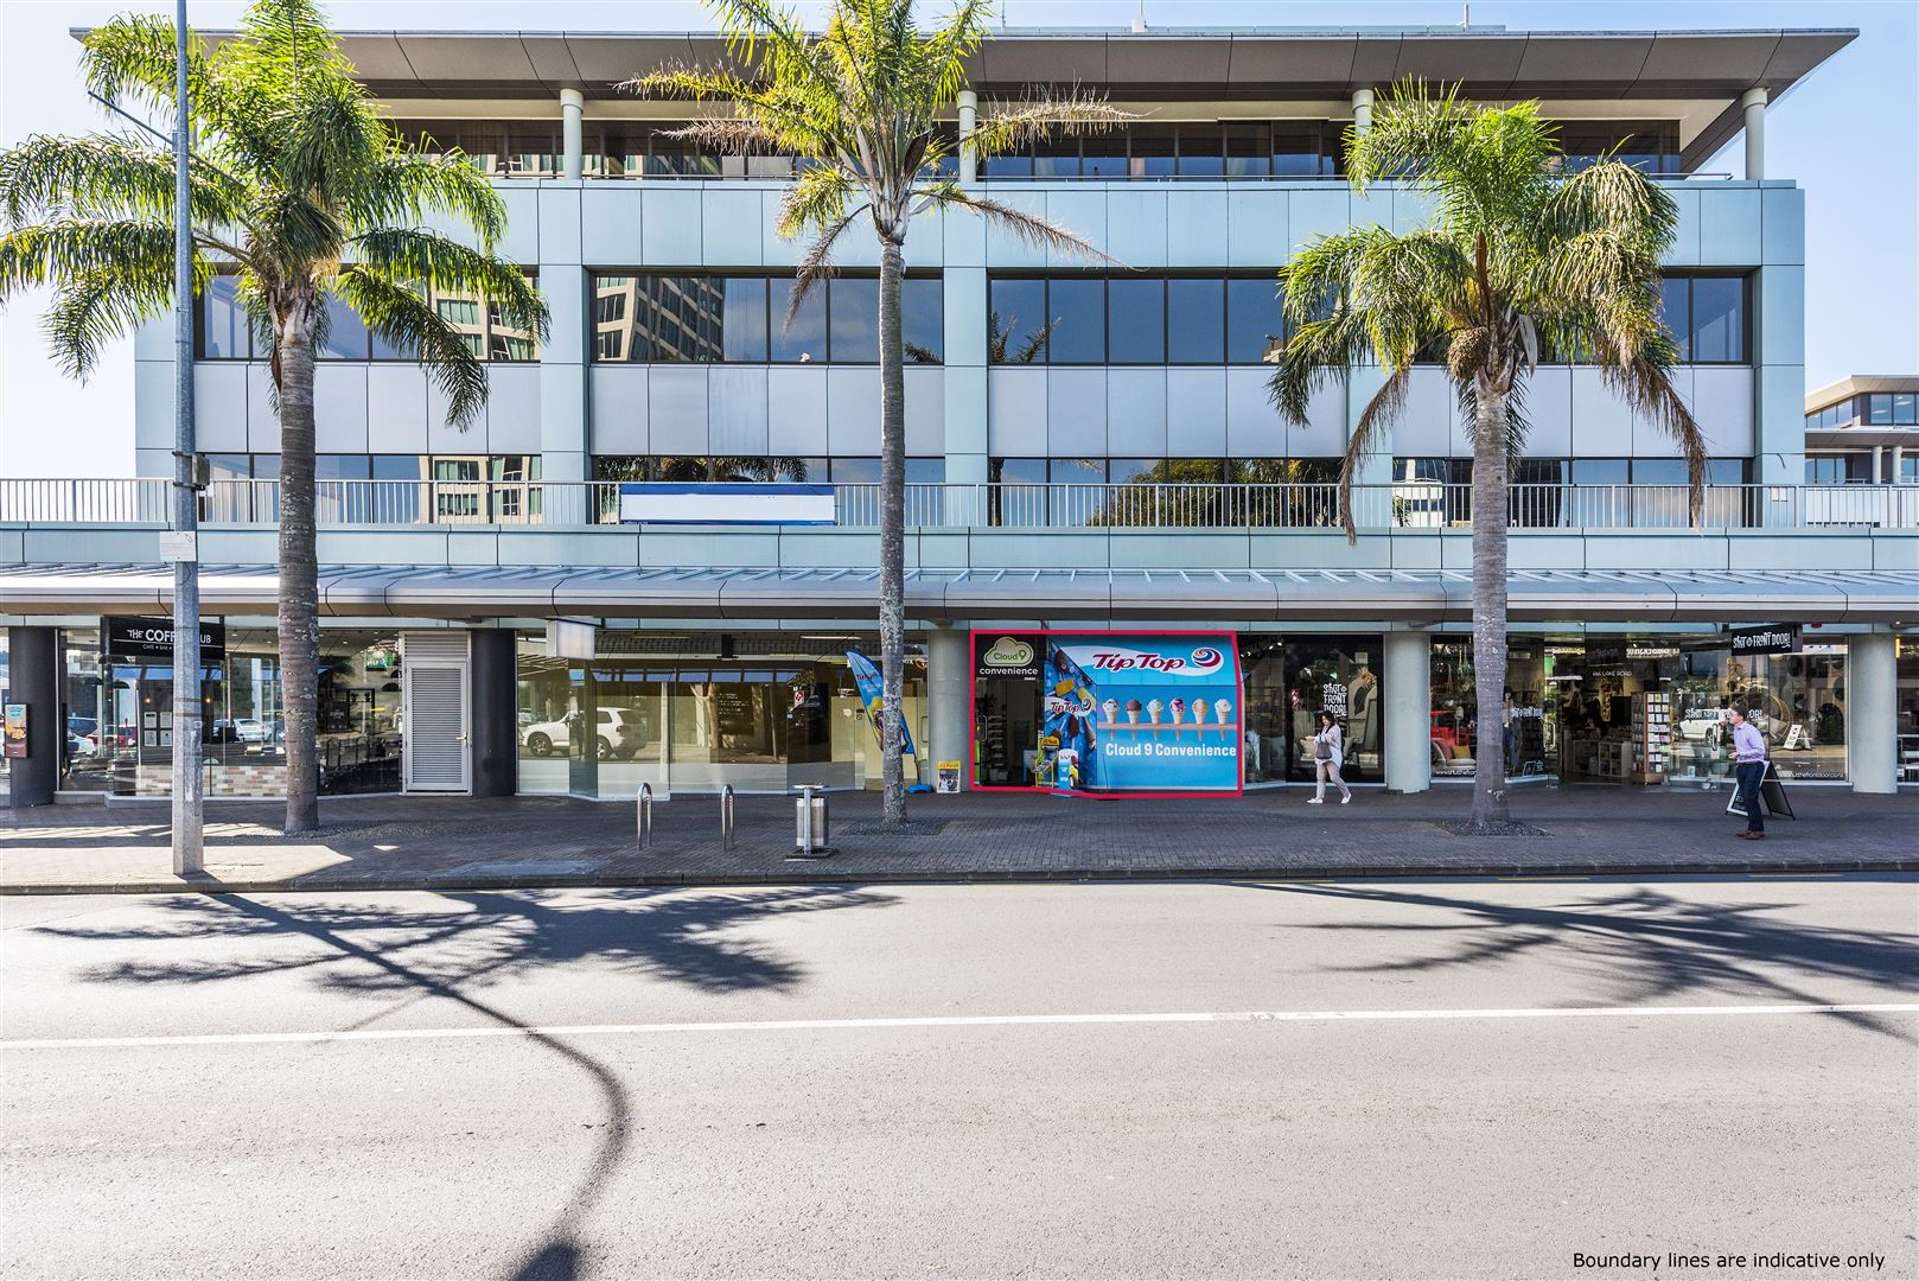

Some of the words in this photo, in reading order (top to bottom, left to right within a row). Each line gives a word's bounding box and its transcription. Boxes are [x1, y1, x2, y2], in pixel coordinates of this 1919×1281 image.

[127, 629, 144, 639] THE
[1753, 631, 1772, 648] FRONT
[993, 652, 1018, 660] Cloud
[1018, 649, 1027, 660] 9
[1093, 653, 1135, 672] Tip
[1136, 653, 1185, 672] Top
[979, 667, 1039, 675] convenience
[1323, 692, 1347, 705] FRONT
[1105, 743, 1141, 757] Cloud
[1144, 743, 1153, 757] 9
[1155, 743, 1237, 757] Convenience
